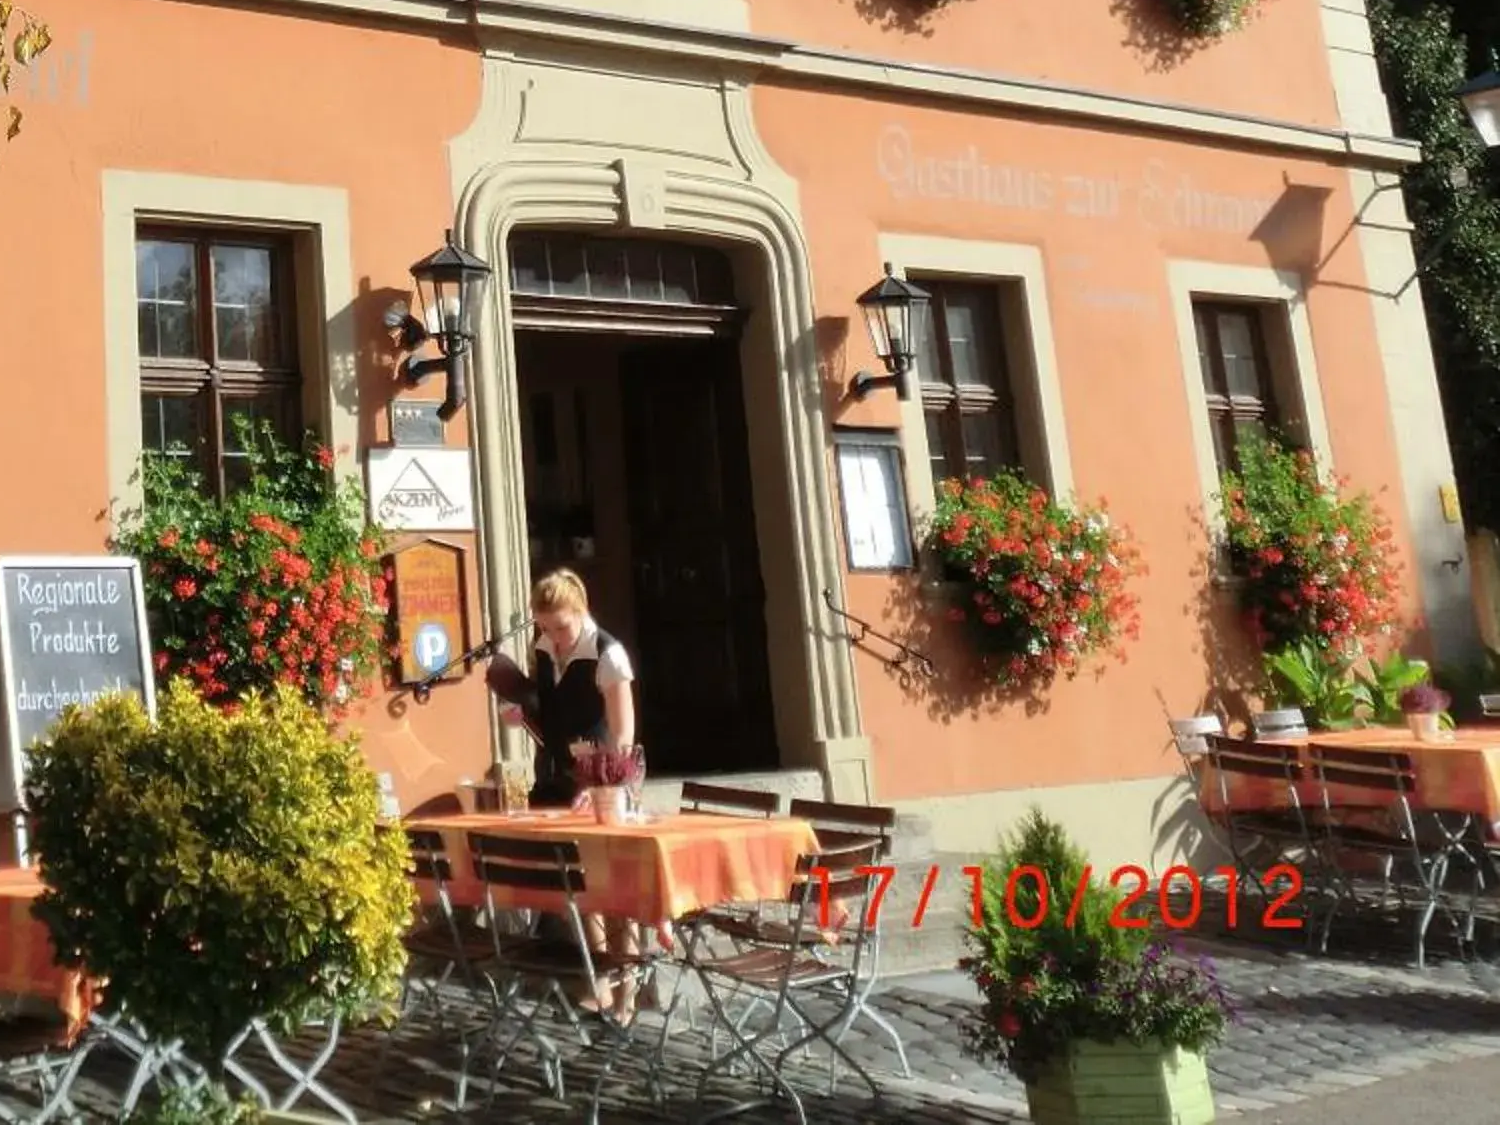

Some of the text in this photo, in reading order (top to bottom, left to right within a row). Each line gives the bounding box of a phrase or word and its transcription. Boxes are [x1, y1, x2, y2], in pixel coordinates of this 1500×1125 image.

[877, 122, 1055, 209] Gasthaus
[17, 573, 122, 616] Regionale
[30, 620, 120, 654] Produkte
